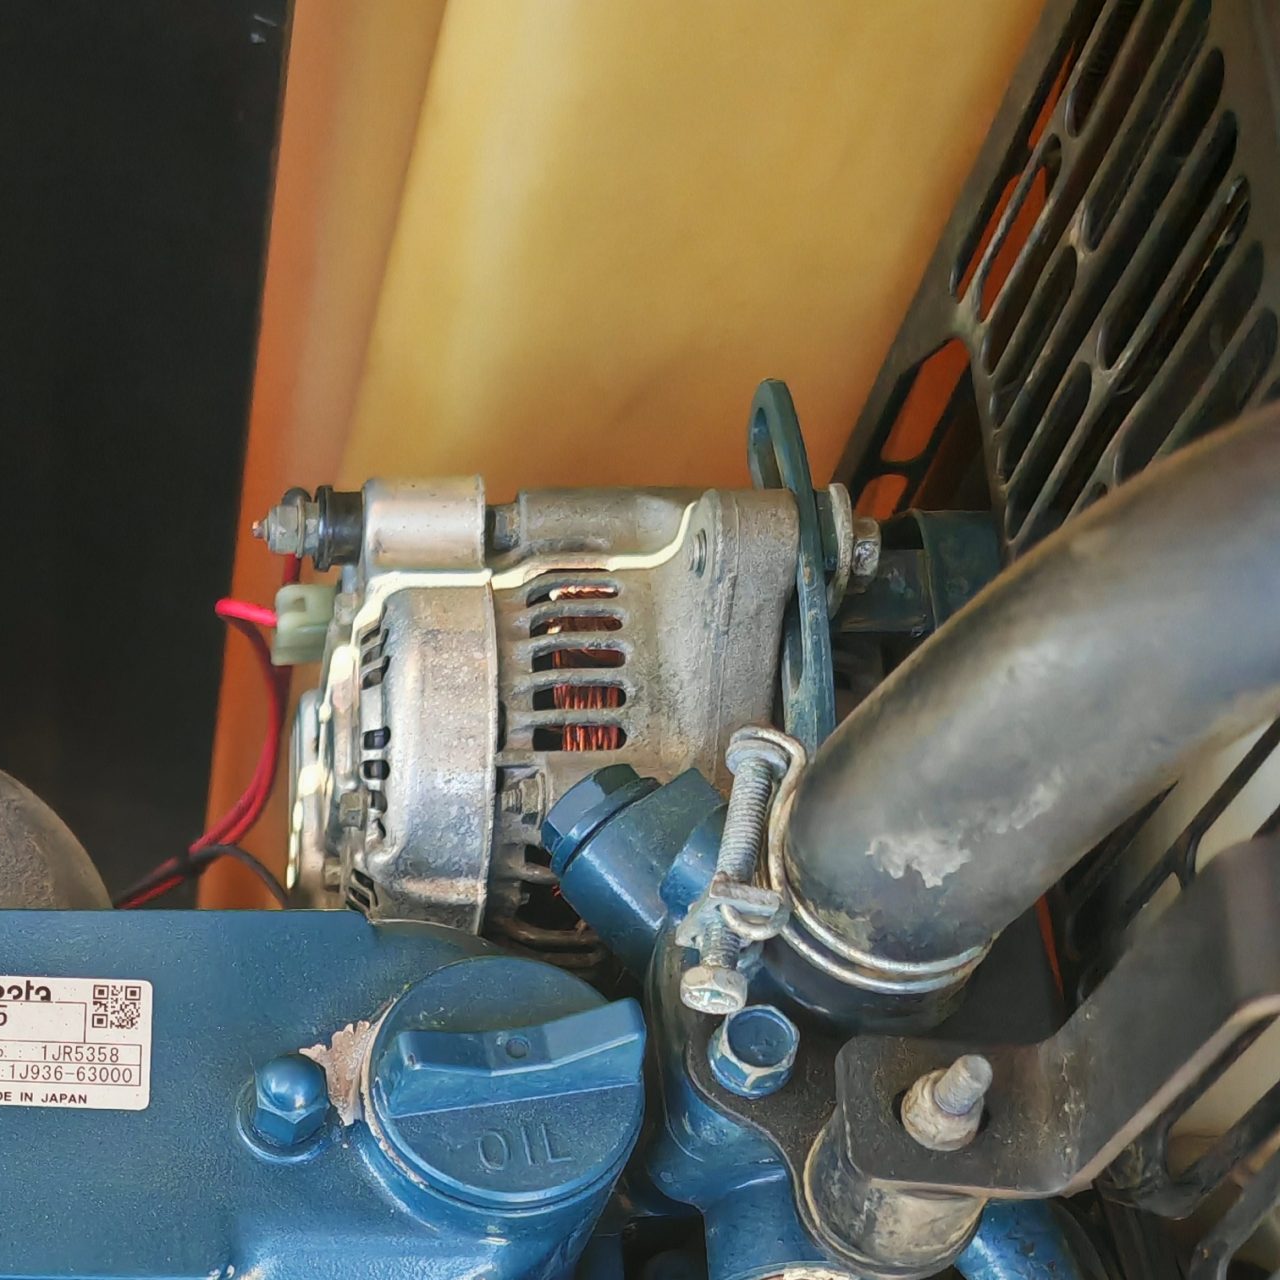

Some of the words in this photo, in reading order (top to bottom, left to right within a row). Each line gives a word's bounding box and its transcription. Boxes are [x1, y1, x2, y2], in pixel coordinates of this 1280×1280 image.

[41, 1045, 120, 1063] 1JR5358
[20, 1092, 34, 1103] IN
[41, 1092, 88, 1104] JAPAN
[476, 1122, 572, 1172] OIL
